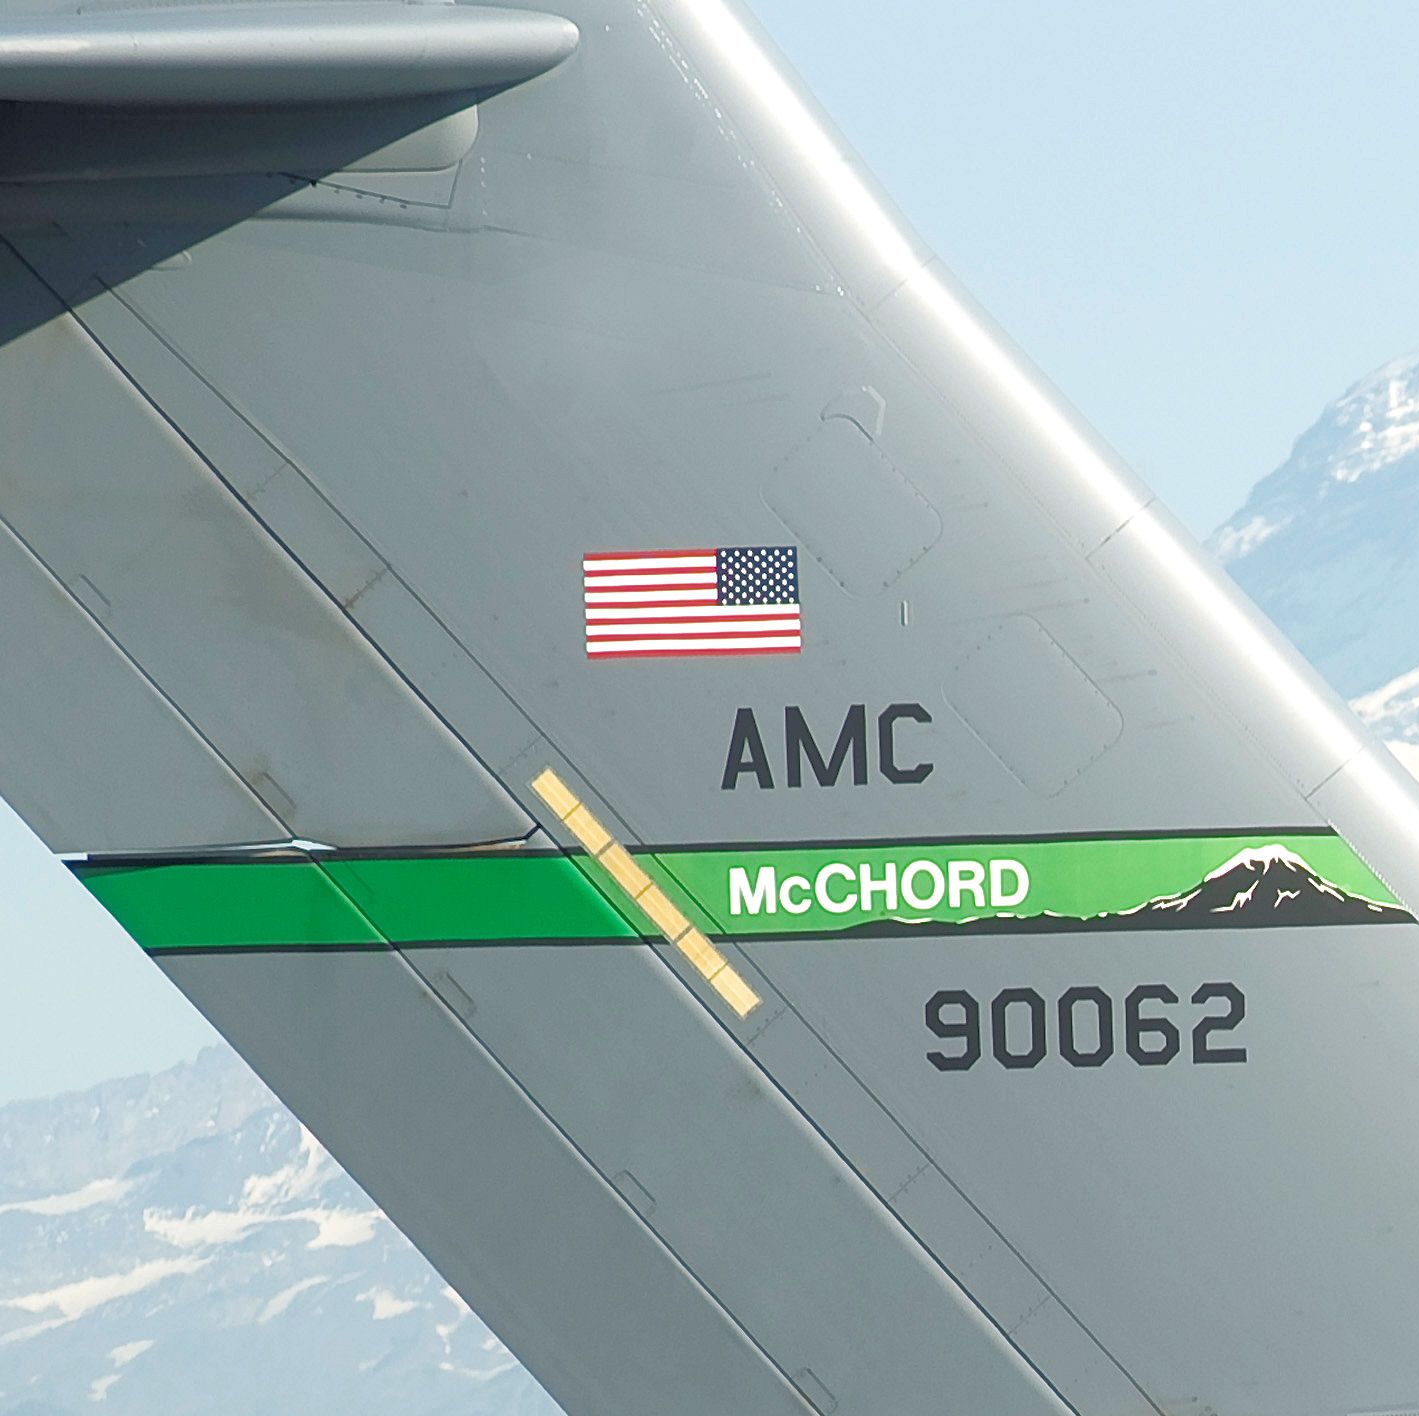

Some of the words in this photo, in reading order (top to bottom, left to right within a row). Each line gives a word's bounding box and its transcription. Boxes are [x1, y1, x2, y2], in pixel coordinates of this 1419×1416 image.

[721, 704, 934, 790] AMC
[728, 859, 1031, 916] McCHORD
[925, 982, 1248, 1073] 90062
